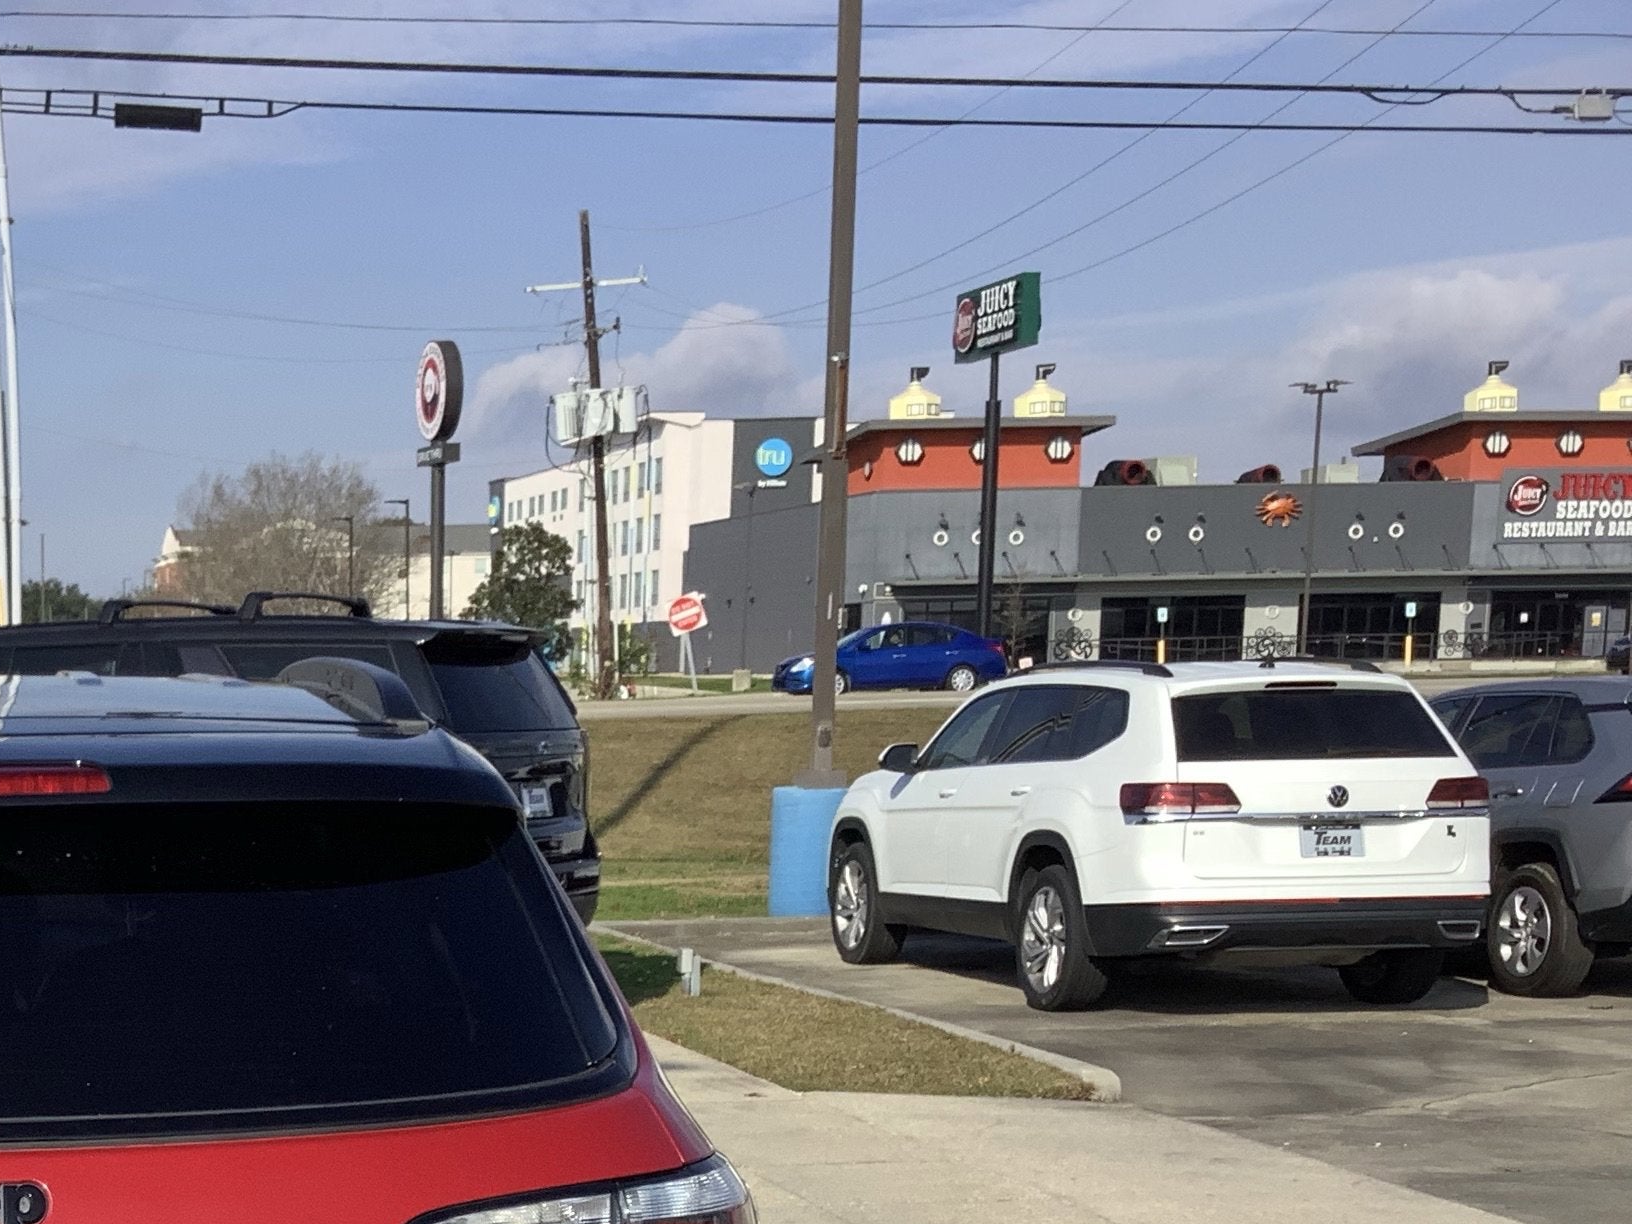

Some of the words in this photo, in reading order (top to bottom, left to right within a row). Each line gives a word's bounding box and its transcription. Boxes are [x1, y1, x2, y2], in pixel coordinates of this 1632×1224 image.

[977, 280, 1017, 317] JUICY
[977, 308, 1015, 335] SEAFOOD
[1556, 501, 1632, 519] SEAFOOD
[1504, 521, 1592, 538] RESTAURANT
[1595, 521, 1605, 536] &
[1314, 831, 1352, 846] TEAM
